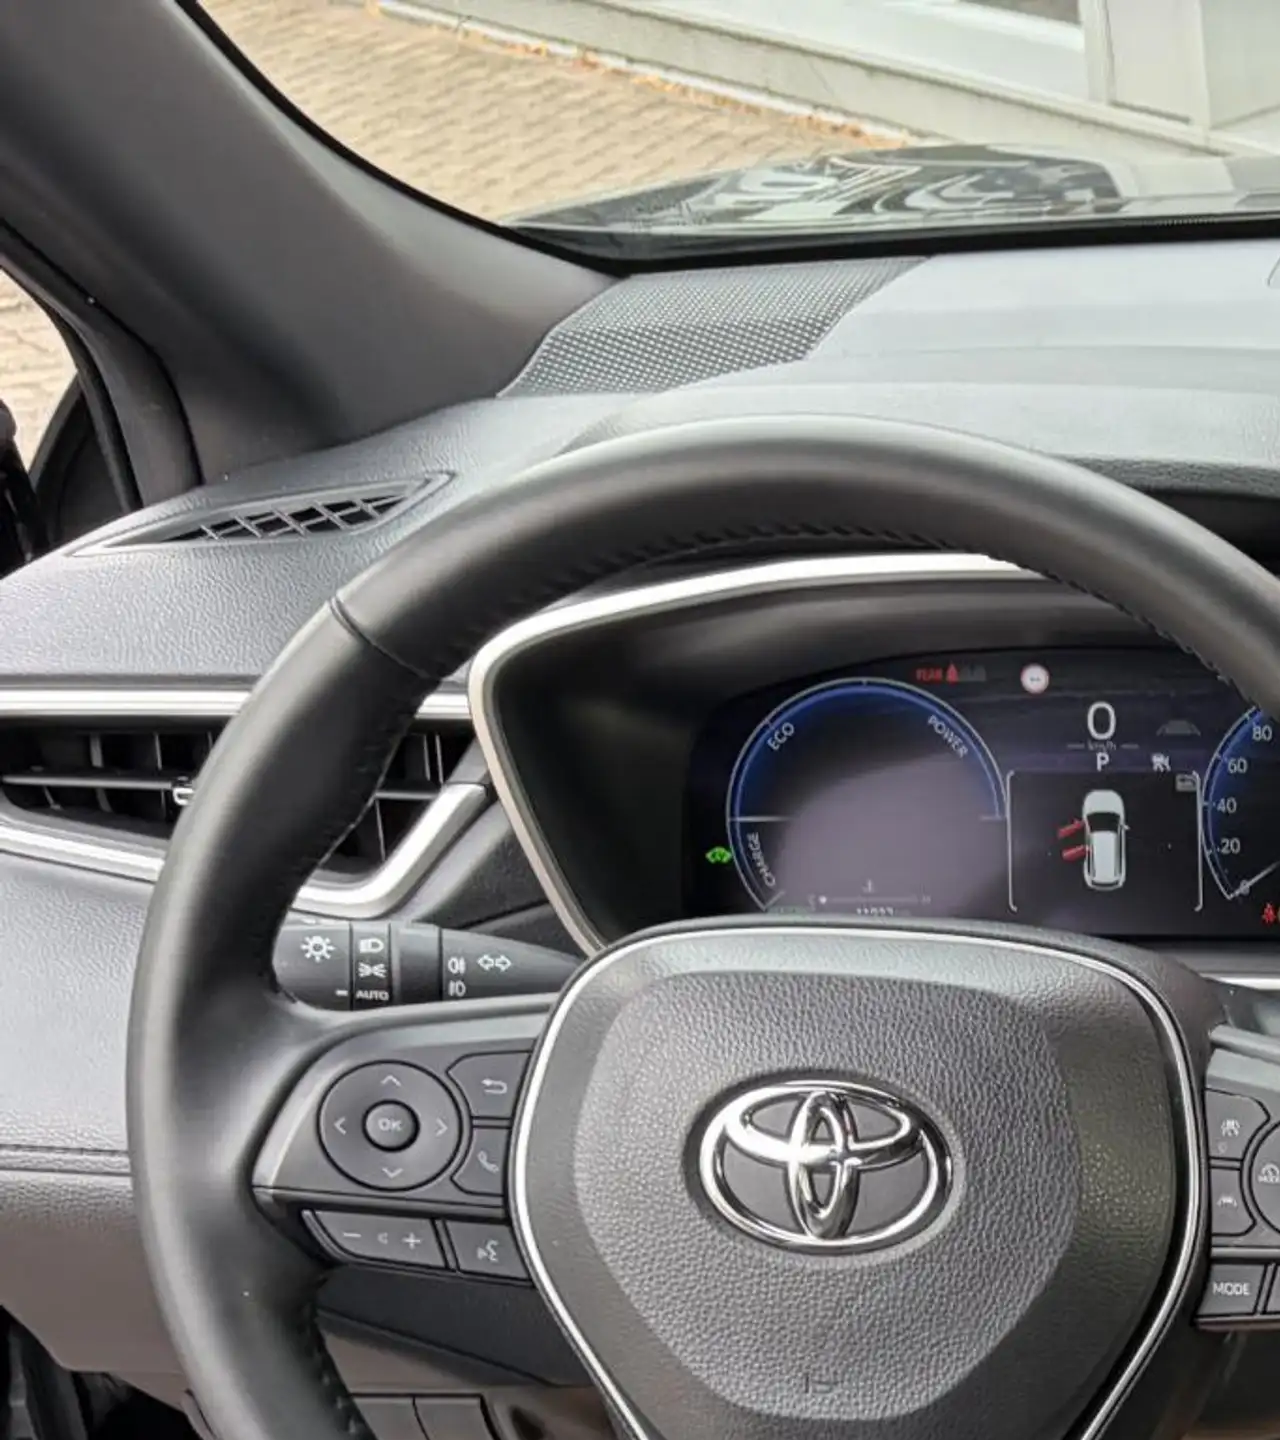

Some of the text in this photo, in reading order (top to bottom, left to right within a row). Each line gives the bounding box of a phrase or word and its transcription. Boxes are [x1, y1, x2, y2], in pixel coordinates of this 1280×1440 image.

[1087, 701, 1117, 741] 0
[766, 721, 796, 751] ECO
[926, 714, 970, 759] POWER
[1252, 725, 1273, 741] 80
[1096, 752, 1110, 772] P
[1227, 757, 1248, 774] 60
[1216, 797, 1238, 814] 40
[1220, 837, 1241, 854] 20
[746, 831, 776, 887] CHARGE
[356, 989, 390, 1001] AUTO
[378, 1118, 403, 1132] OK
[1212, 1282, 1251, 1296] MODE
